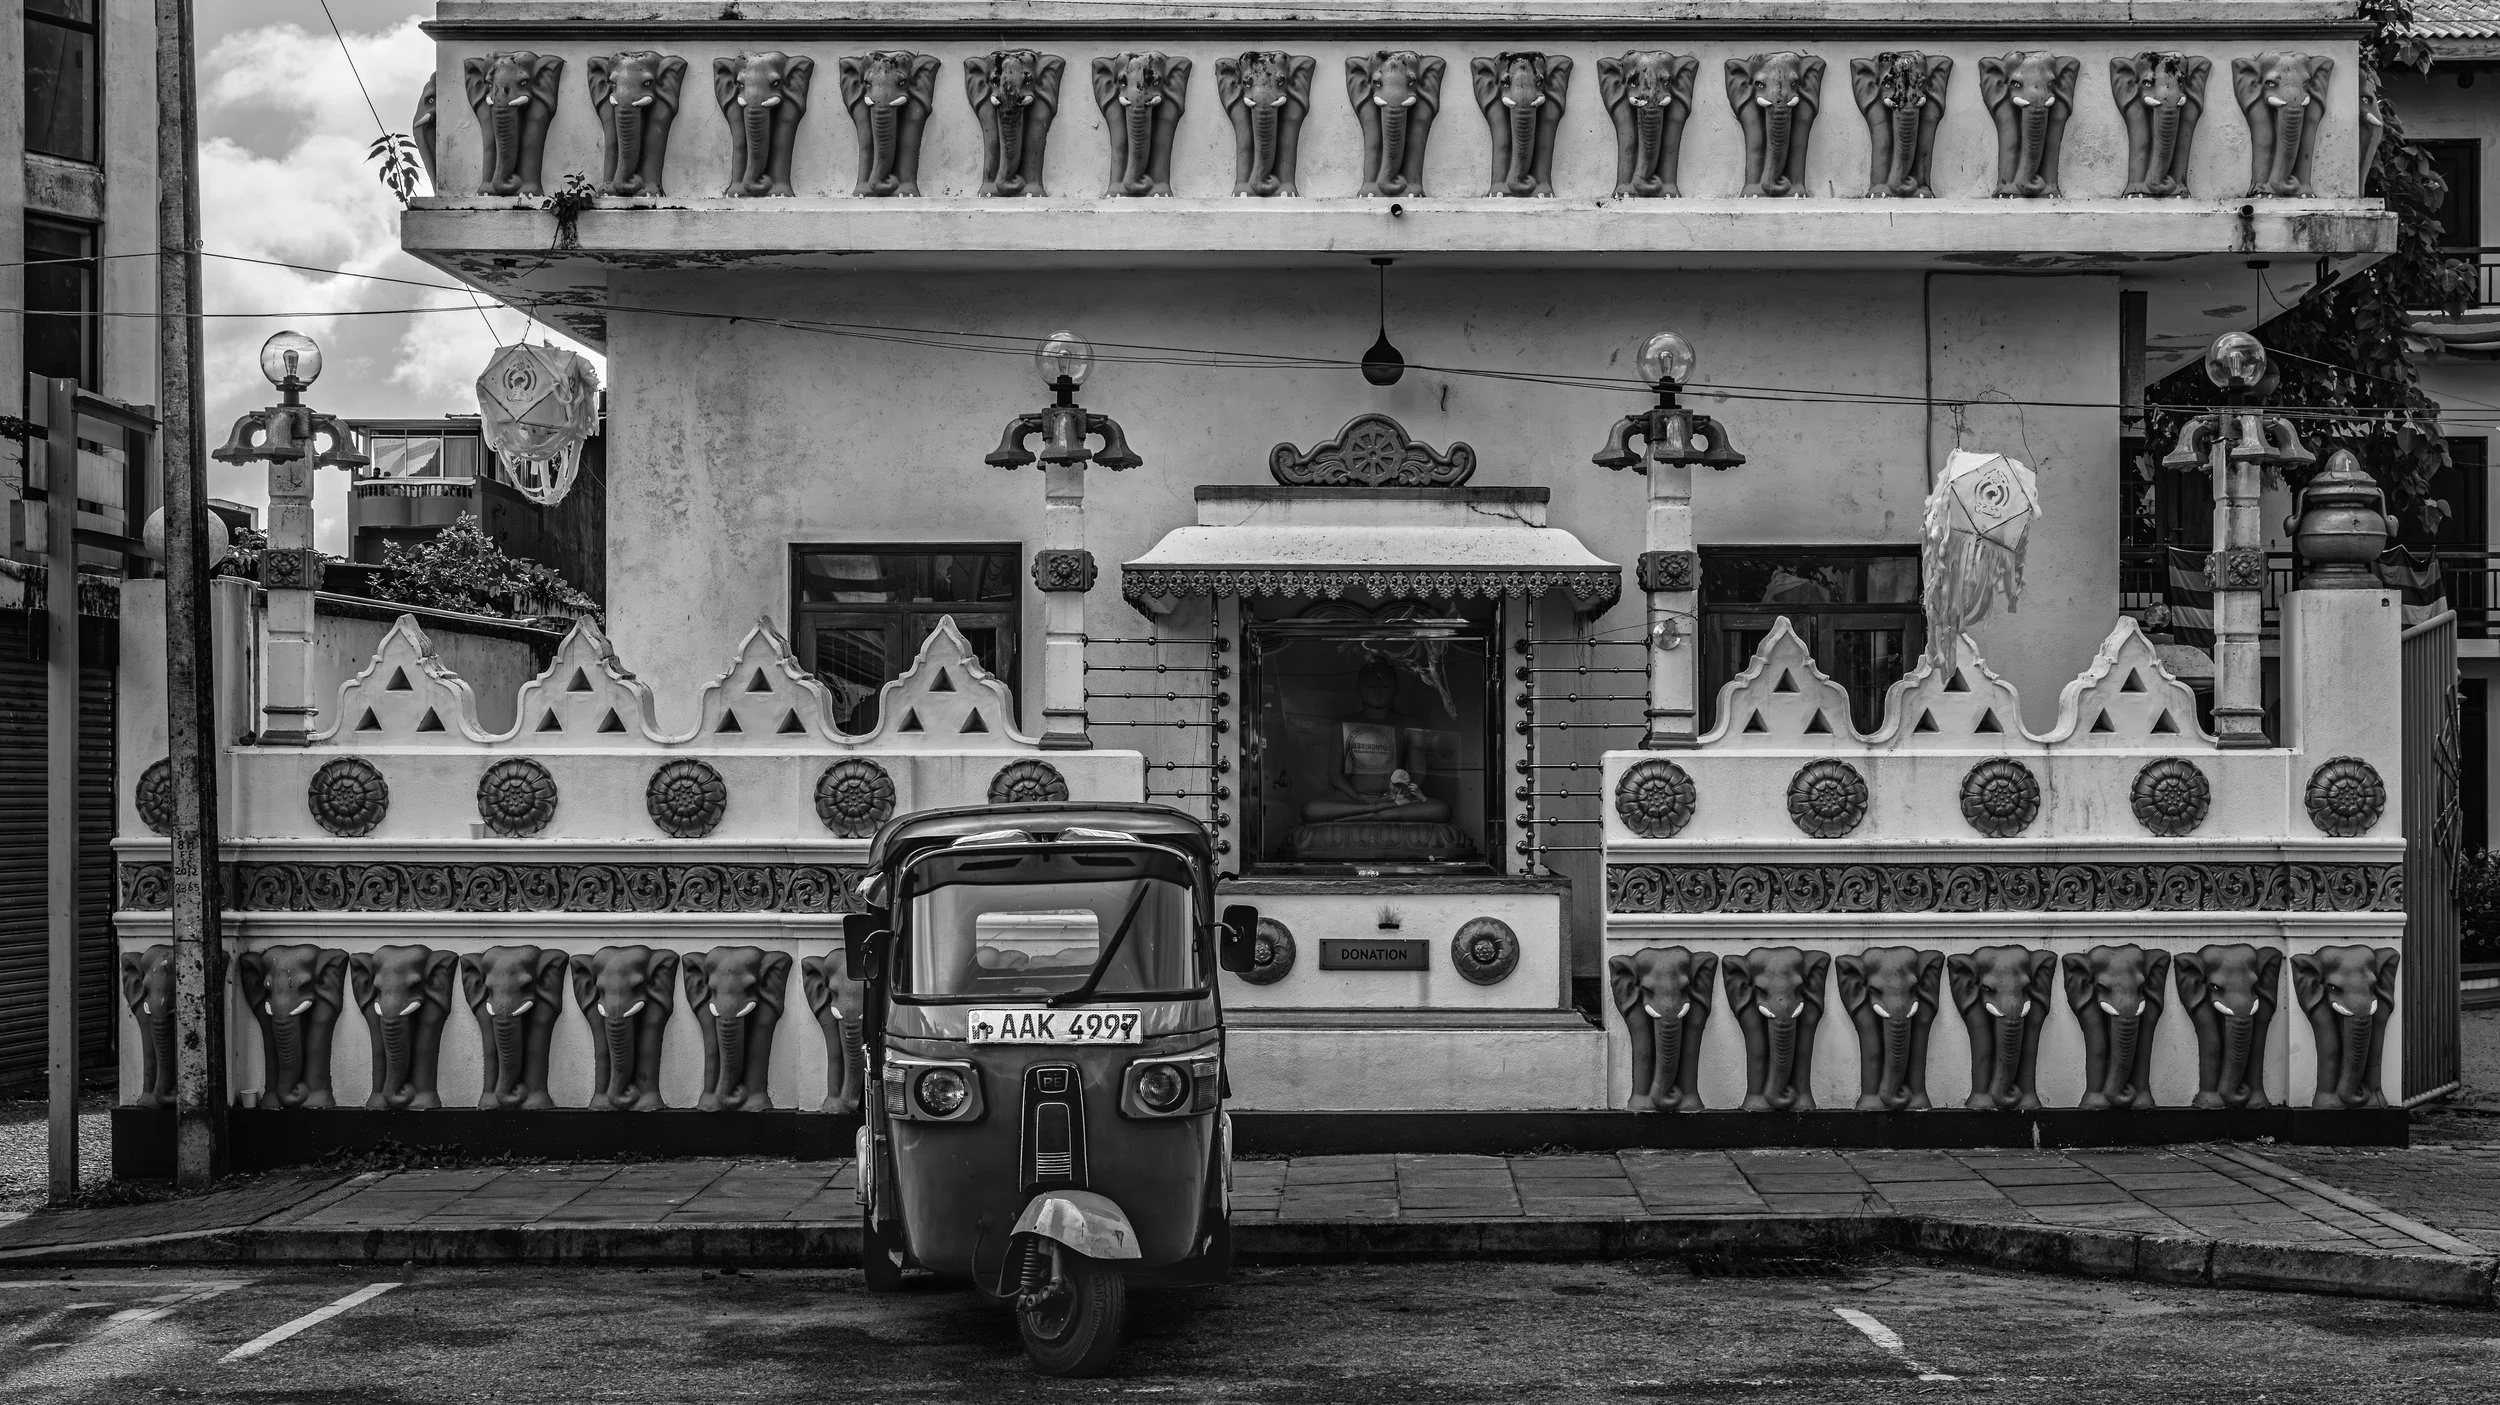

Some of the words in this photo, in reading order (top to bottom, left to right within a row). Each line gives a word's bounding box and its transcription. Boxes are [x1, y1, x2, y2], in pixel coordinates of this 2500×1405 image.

[175, 866, 198, 876] 2012
[1342, 948, 1407, 960] DONATION
[1000, 1013, 1055, 1040] AAK
[1068, 1013, 1138, 1040] 4997
[1043, 1077, 1063, 1088] RE
